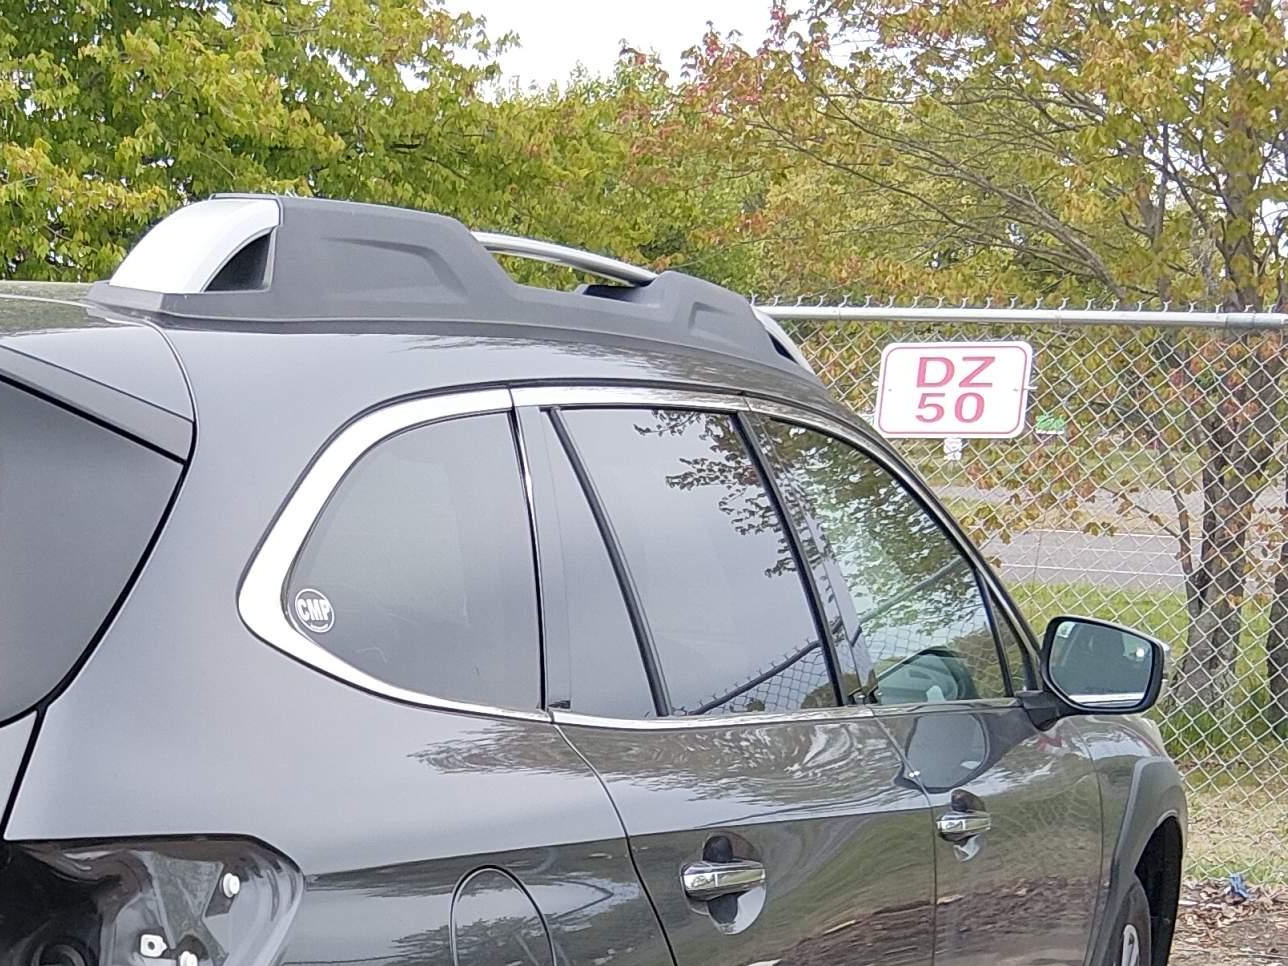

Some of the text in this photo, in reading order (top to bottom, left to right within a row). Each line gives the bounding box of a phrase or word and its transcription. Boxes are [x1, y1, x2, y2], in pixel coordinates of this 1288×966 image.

[916, 356, 996, 388] DZ
[915, 392, 985, 423] 50
[297, 598, 330, 621] CMP
